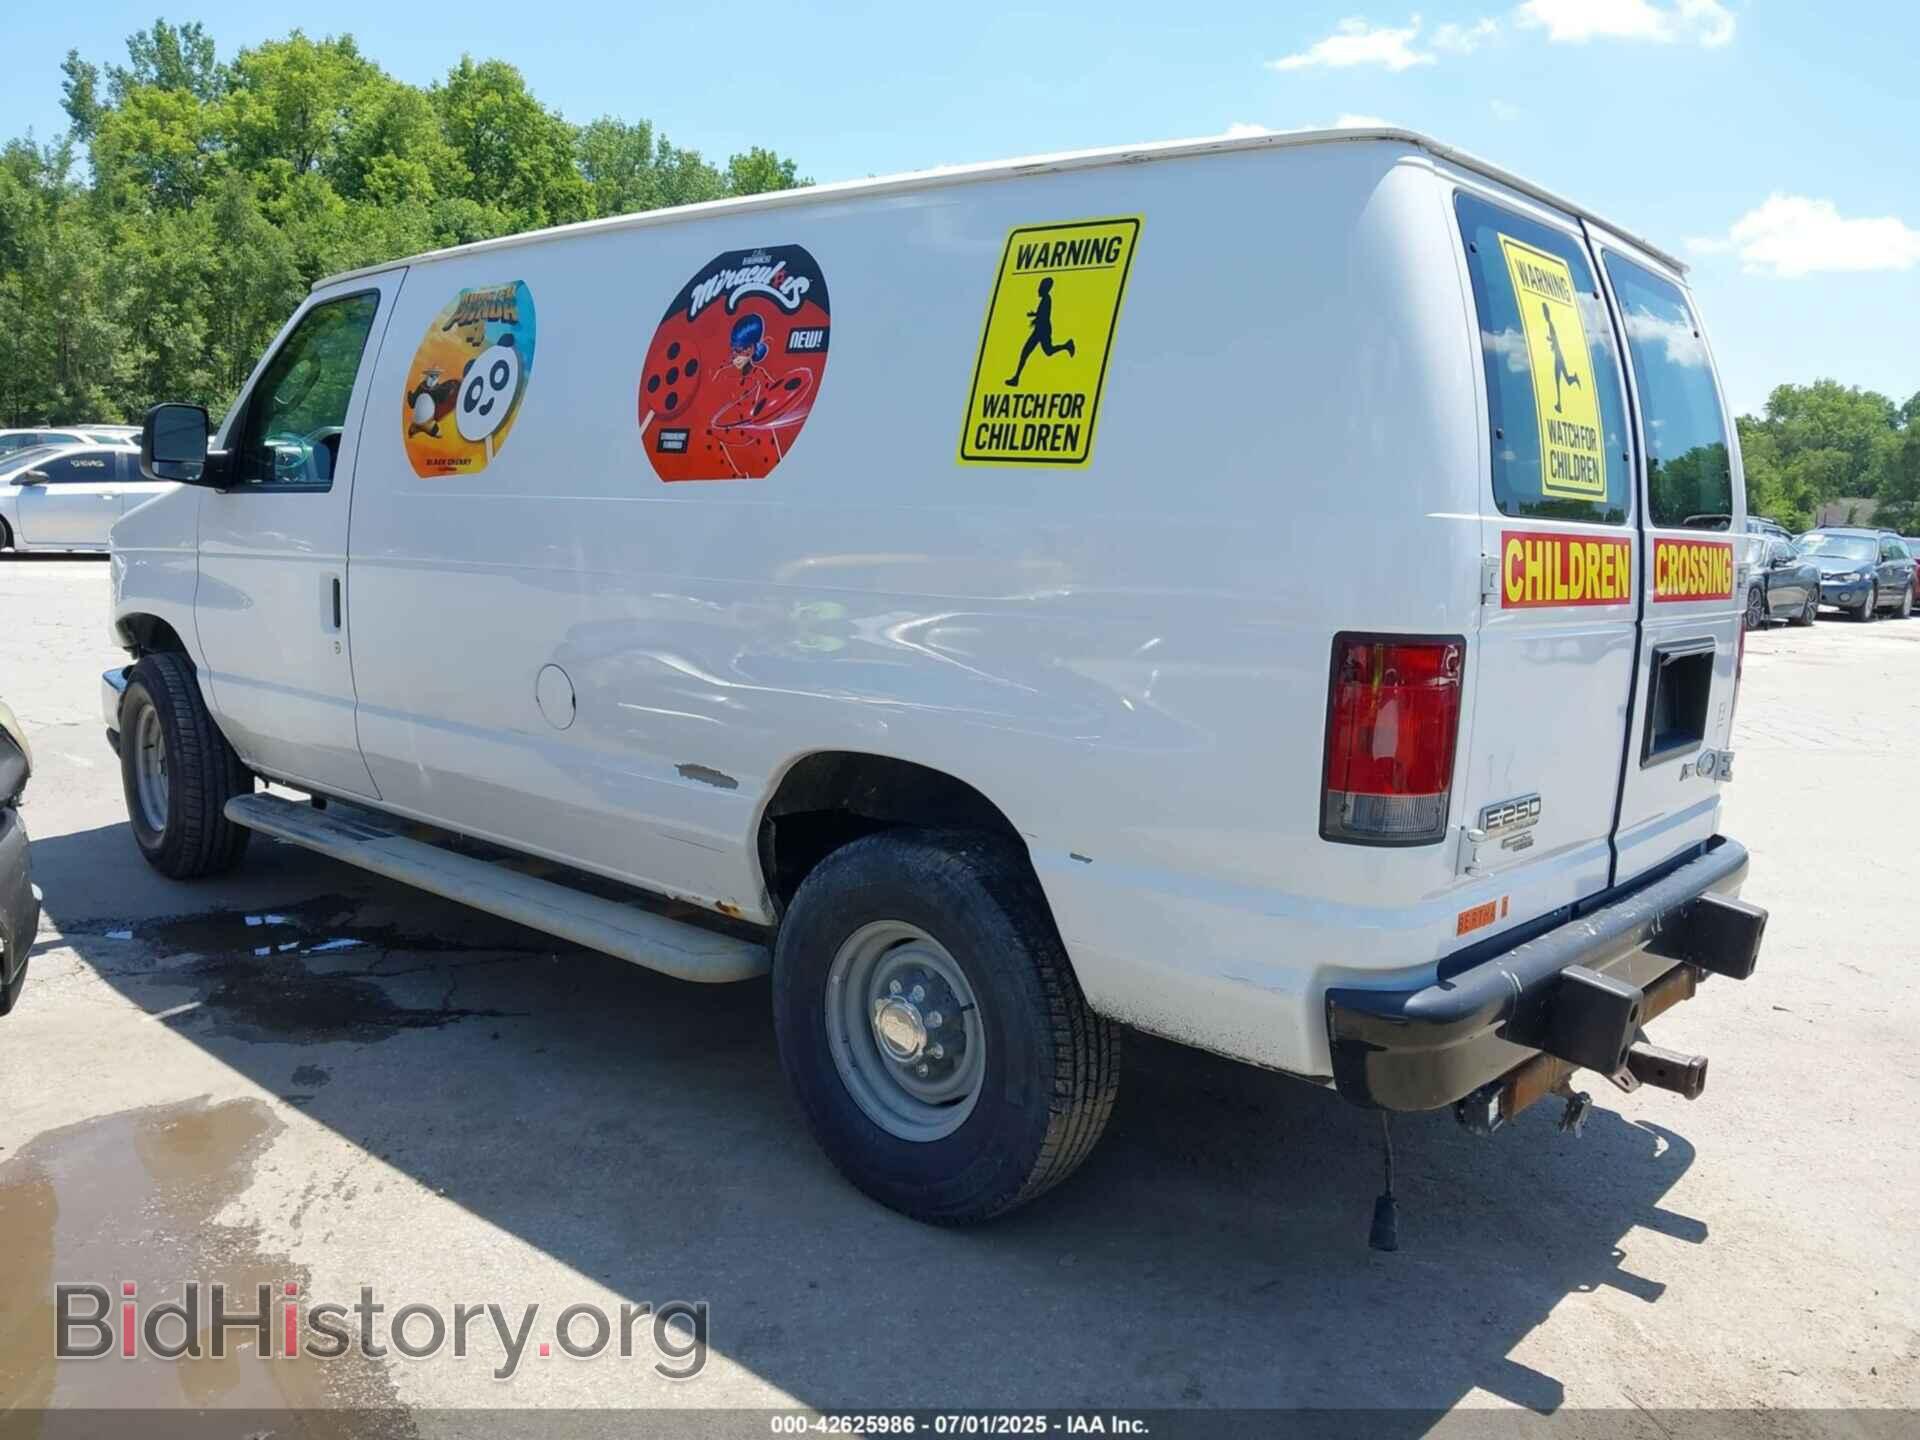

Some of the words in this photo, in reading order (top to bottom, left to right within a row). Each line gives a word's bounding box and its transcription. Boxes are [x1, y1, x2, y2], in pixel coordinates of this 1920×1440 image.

[1016, 236, 1123, 270] WARNING
[1516, 259, 1571, 302] WARNING
[788, 330, 824, 349] NEW!
[983, 393, 1046, 419] WATCH
[1047, 393, 1086, 419] FOR
[975, 422, 1081, 453] CHILDREN
[1546, 419, 1580, 447] WATCH
[1579, 430, 1598, 450] FOR
[1549, 450, 1600, 484] CHILDREN
[1504, 538, 1630, 602] CHILDREN
[1656, 543, 1732, 596] CROSSING
